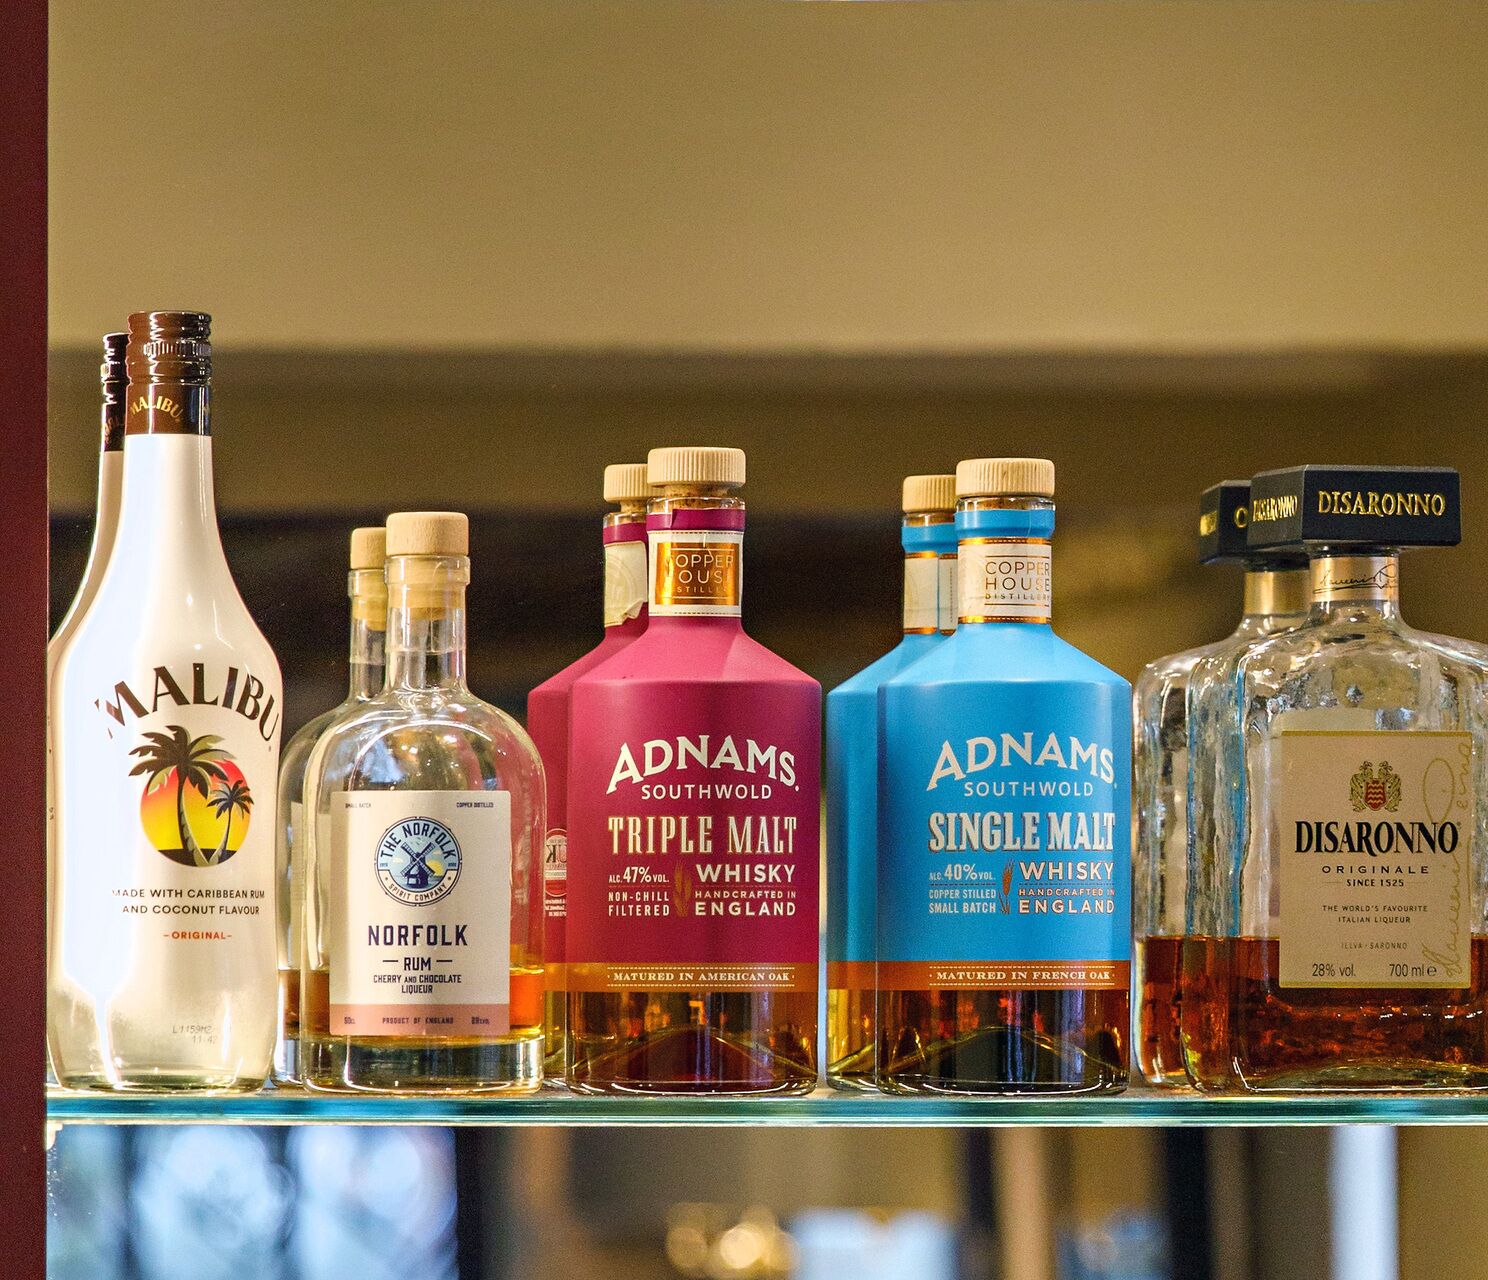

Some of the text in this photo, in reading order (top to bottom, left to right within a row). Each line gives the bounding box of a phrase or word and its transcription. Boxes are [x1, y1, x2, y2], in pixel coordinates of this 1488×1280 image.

[1318, 490, 1446, 518] DISARONNO
[94, 662, 280, 750] MALIBU
[606, 734, 797, 795] ADNAMS
[926, 731, 1115, 792] ADNAMS
[641, 784, 772, 800] SOUTHWOLD
[964, 781, 1094, 798] SOUTHWOLD
[608, 815, 797, 854] TRIPLE MALT
[928, 811, 1116, 854] SINGLE MALT
[1294, 820, 1459, 858] DISARONNO
[380, 822, 457, 860] THE NORFOLK
[695, 863, 796, 883] WHISKY
[1020, 860, 1115, 882] WHISKY
[1321, 865, 1430, 874] ORIGINALE
[1346, 878, 1405, 888] SINCE 1525
[608, 890, 670, 902] NON-CHILL
[694, 890, 796, 900] HANDCRAFTED IN
[929, 889, 996, 900] COPPER STILLED
[122, 904, 260, 916] AND COCONUT FLAVOUR
[608, 904, 670, 917] FILTERED
[694, 902, 796, 916] ENGLAND
[929, 902, 996, 914] SMALL BATCH
[1018, 899, 1115, 915] ENGLAND
[171, 930, 226, 940] ORIGINAL
[368, 924, 468, 947] NORFOLK
[403, 956, 432, 972] RUM
[373, 974, 462, 984] CHERRY AND CHOCOLATE
[612, 972, 790, 982] MATURED IN AMERICAN OAK
[936, 970, 1110, 980] MATURED IN FRENCH OAK
[401, 984, 434, 995] LIQUEUR
